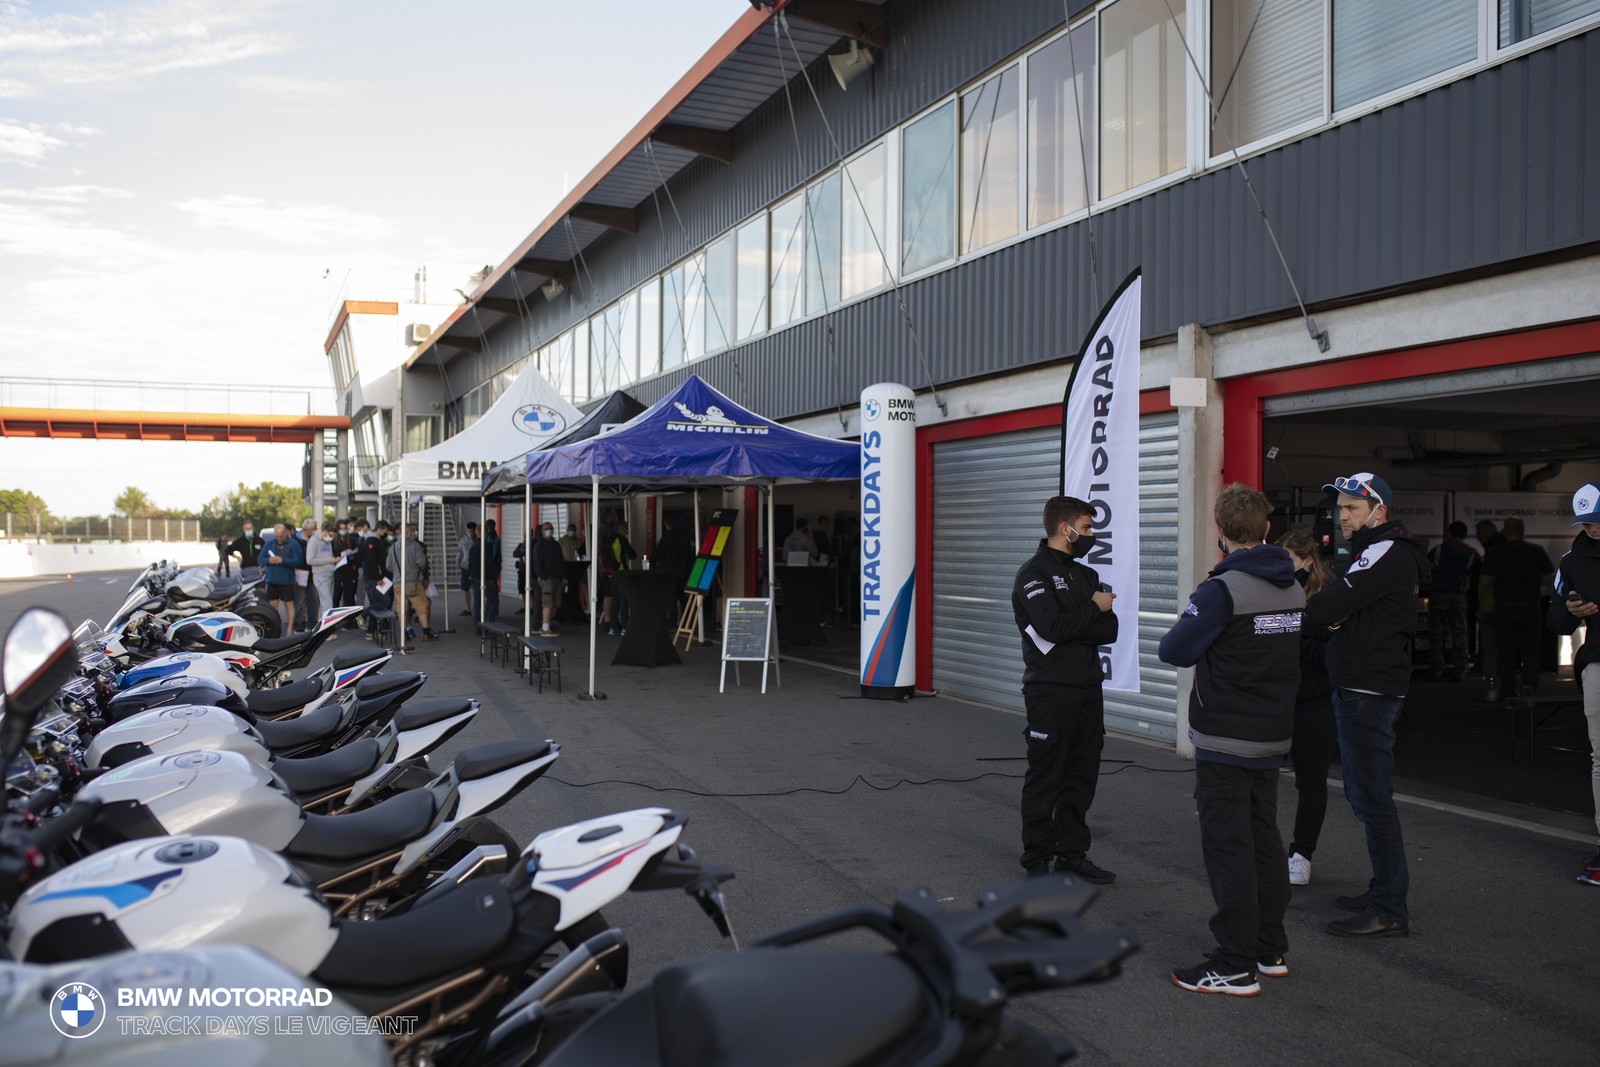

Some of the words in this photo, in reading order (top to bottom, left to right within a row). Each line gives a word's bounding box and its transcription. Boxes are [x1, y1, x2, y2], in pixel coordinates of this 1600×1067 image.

[888, 398, 915, 409] BMW
[667, 424, 768, 434] MICHELIN
[1474, 508, 1493, 516] BMW
[1494, 508, 1536, 516] MOTORRAD
[863, 430, 882, 621] TRACKDAYS
[1254, 627, 1285, 635] RACING
